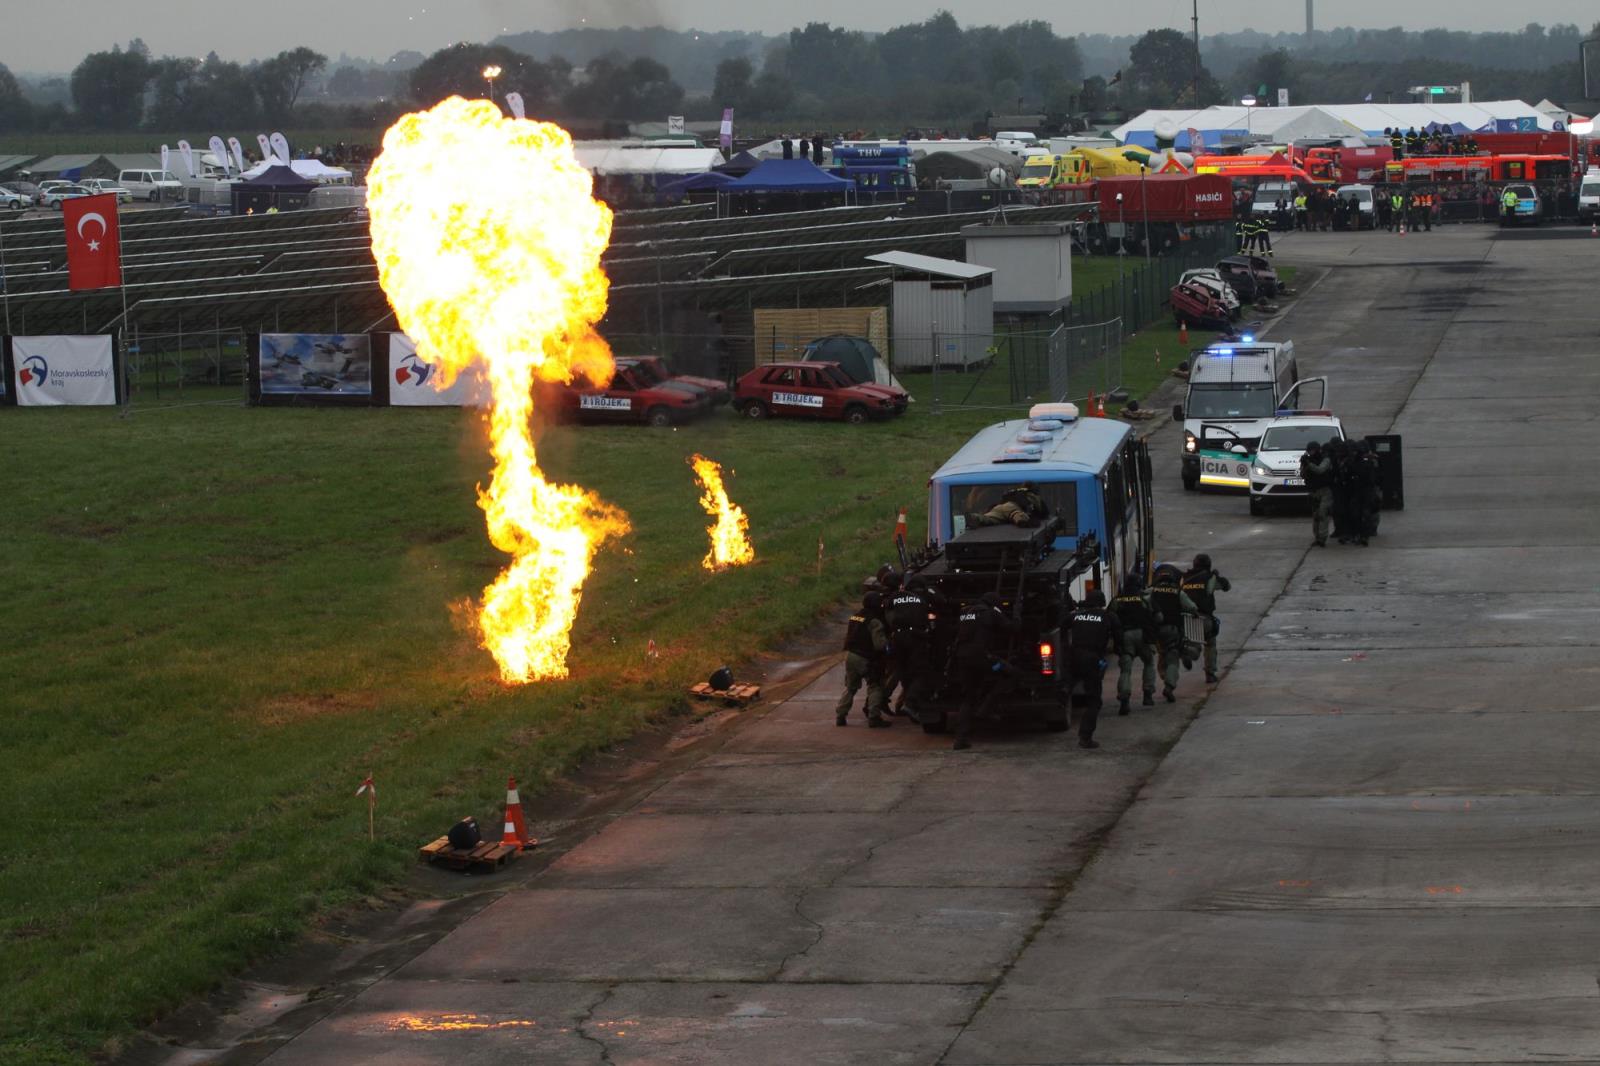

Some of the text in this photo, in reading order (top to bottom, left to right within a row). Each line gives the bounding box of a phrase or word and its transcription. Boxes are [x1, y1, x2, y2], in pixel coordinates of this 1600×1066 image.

[1523, 119, 1530, 131] 2
[858, 149, 881, 157] THW
[1195, 192, 1222, 202] HASIČI
[51, 378, 64, 387] kraj
[783, 393, 814, 404] TROJEK
[894, 595, 921, 606] POLÍCIA
[1074, 614, 1102, 622] POLÍCIA
